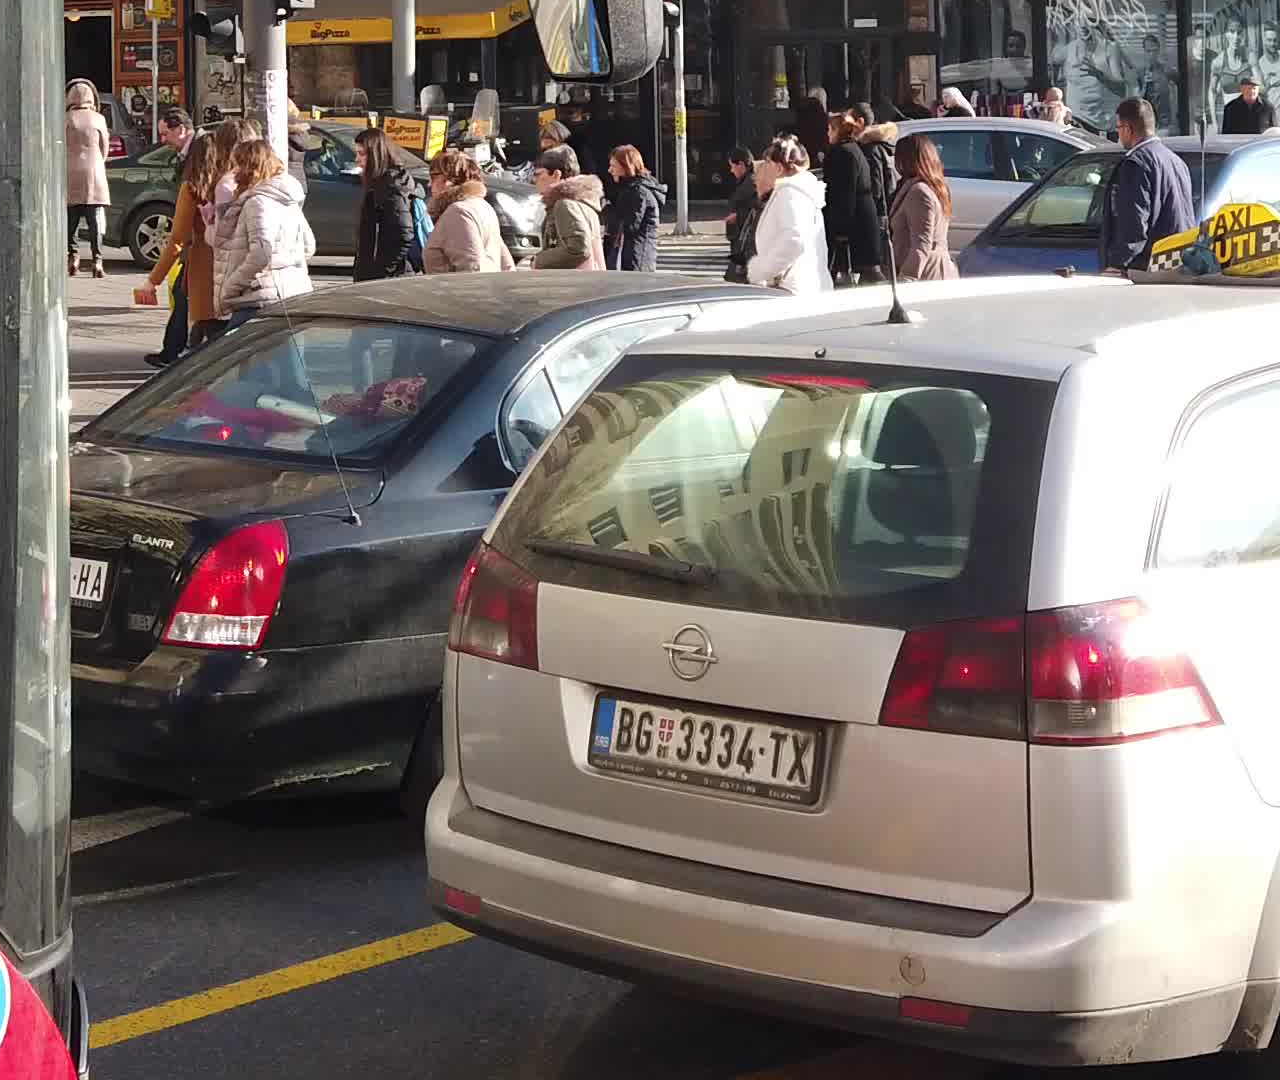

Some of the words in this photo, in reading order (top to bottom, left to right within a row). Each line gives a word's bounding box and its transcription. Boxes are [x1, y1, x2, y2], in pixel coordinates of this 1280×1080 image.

[416, 26, 441, 35] Pizza
[1199, 205, 1252, 238] TAXI
[1214, 231, 1256, 264] UTI
[616, 707, 654, 756] BG
